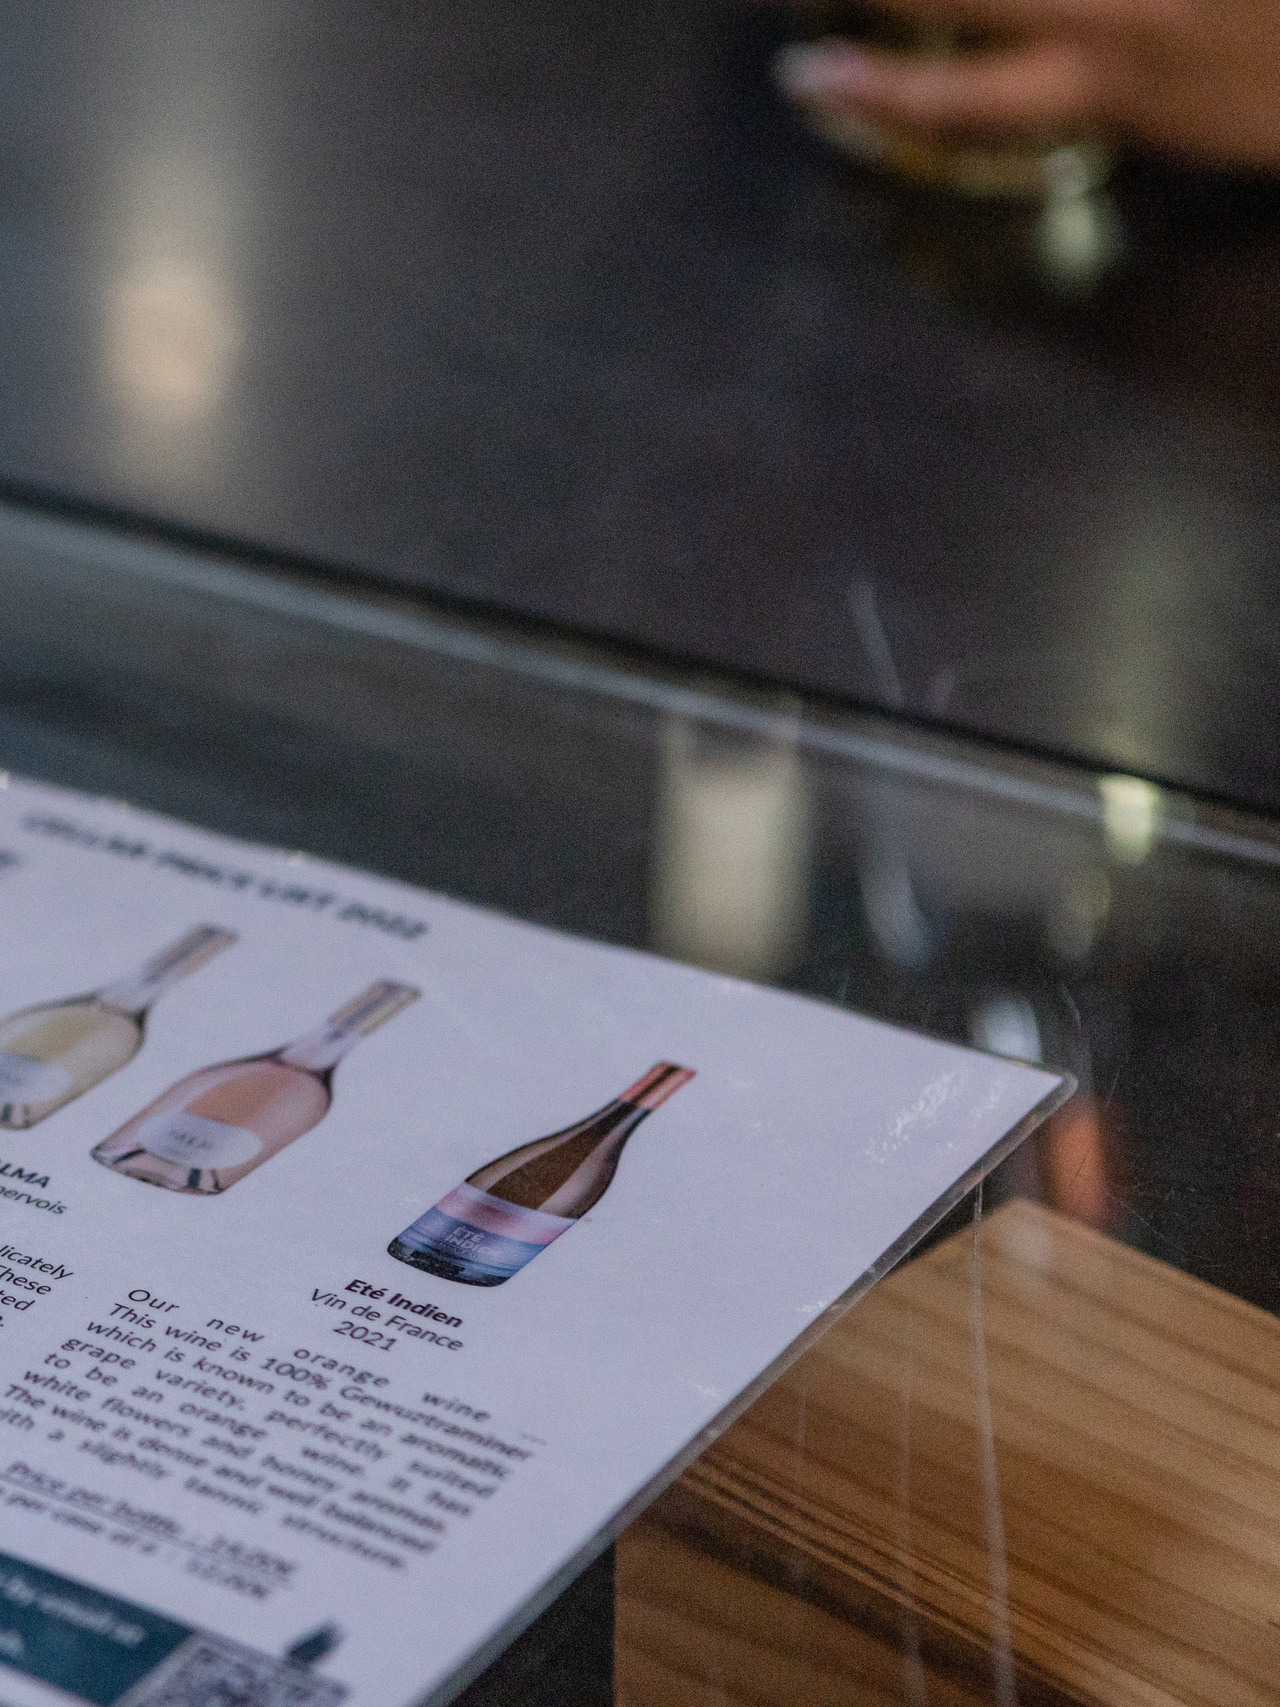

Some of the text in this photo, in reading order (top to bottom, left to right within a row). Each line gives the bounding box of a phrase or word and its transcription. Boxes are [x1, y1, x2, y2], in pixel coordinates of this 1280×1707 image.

[109, 1302, 157, 1330] This
[164, 1324, 223, 1352] wine
[229, 1346, 252, 1363] is
[260, 1356, 332, 1391] 100%
[311, 1289, 464, 1351] Vin de France
[333, 1321, 398, 1351] 2021
[344, 1279, 463, 1328] Eté Indien
[44, 1352, 71, 1370] to
[85, 1366, 118, 1387] be
[131, 1386, 165, 1404] an
[178, 1402, 268, 1440] orange
[61, 1338, 137, 1370] grape
[264, 1409, 388, 1462] perfectly
[86, 1321, 157, 1353] which
[163, 1346, 186, 1364] is
[192, 1356, 275, 1395] known
[283, 1389, 311, 1407] to
[319, 1401, 352, 1422] be
[358, 1417, 394, 1438] an
[128, 1289, 180, 1313] Our
[206, 1318, 266, 1343] new
[293, 1348, 391, 1388] orange
[422, 1391, 491, 1423] wine
[4, 1383, 46, 1409] The
[51, 1405, 107, 1433] wine
[136, 1437, 209, 1468] dense
[214, 1466, 265, 1488] and
[23, 1370, 91, 1401] white
[100, 1395, 193, 1438] flowers
[201, 1435, 255, 1460] and
